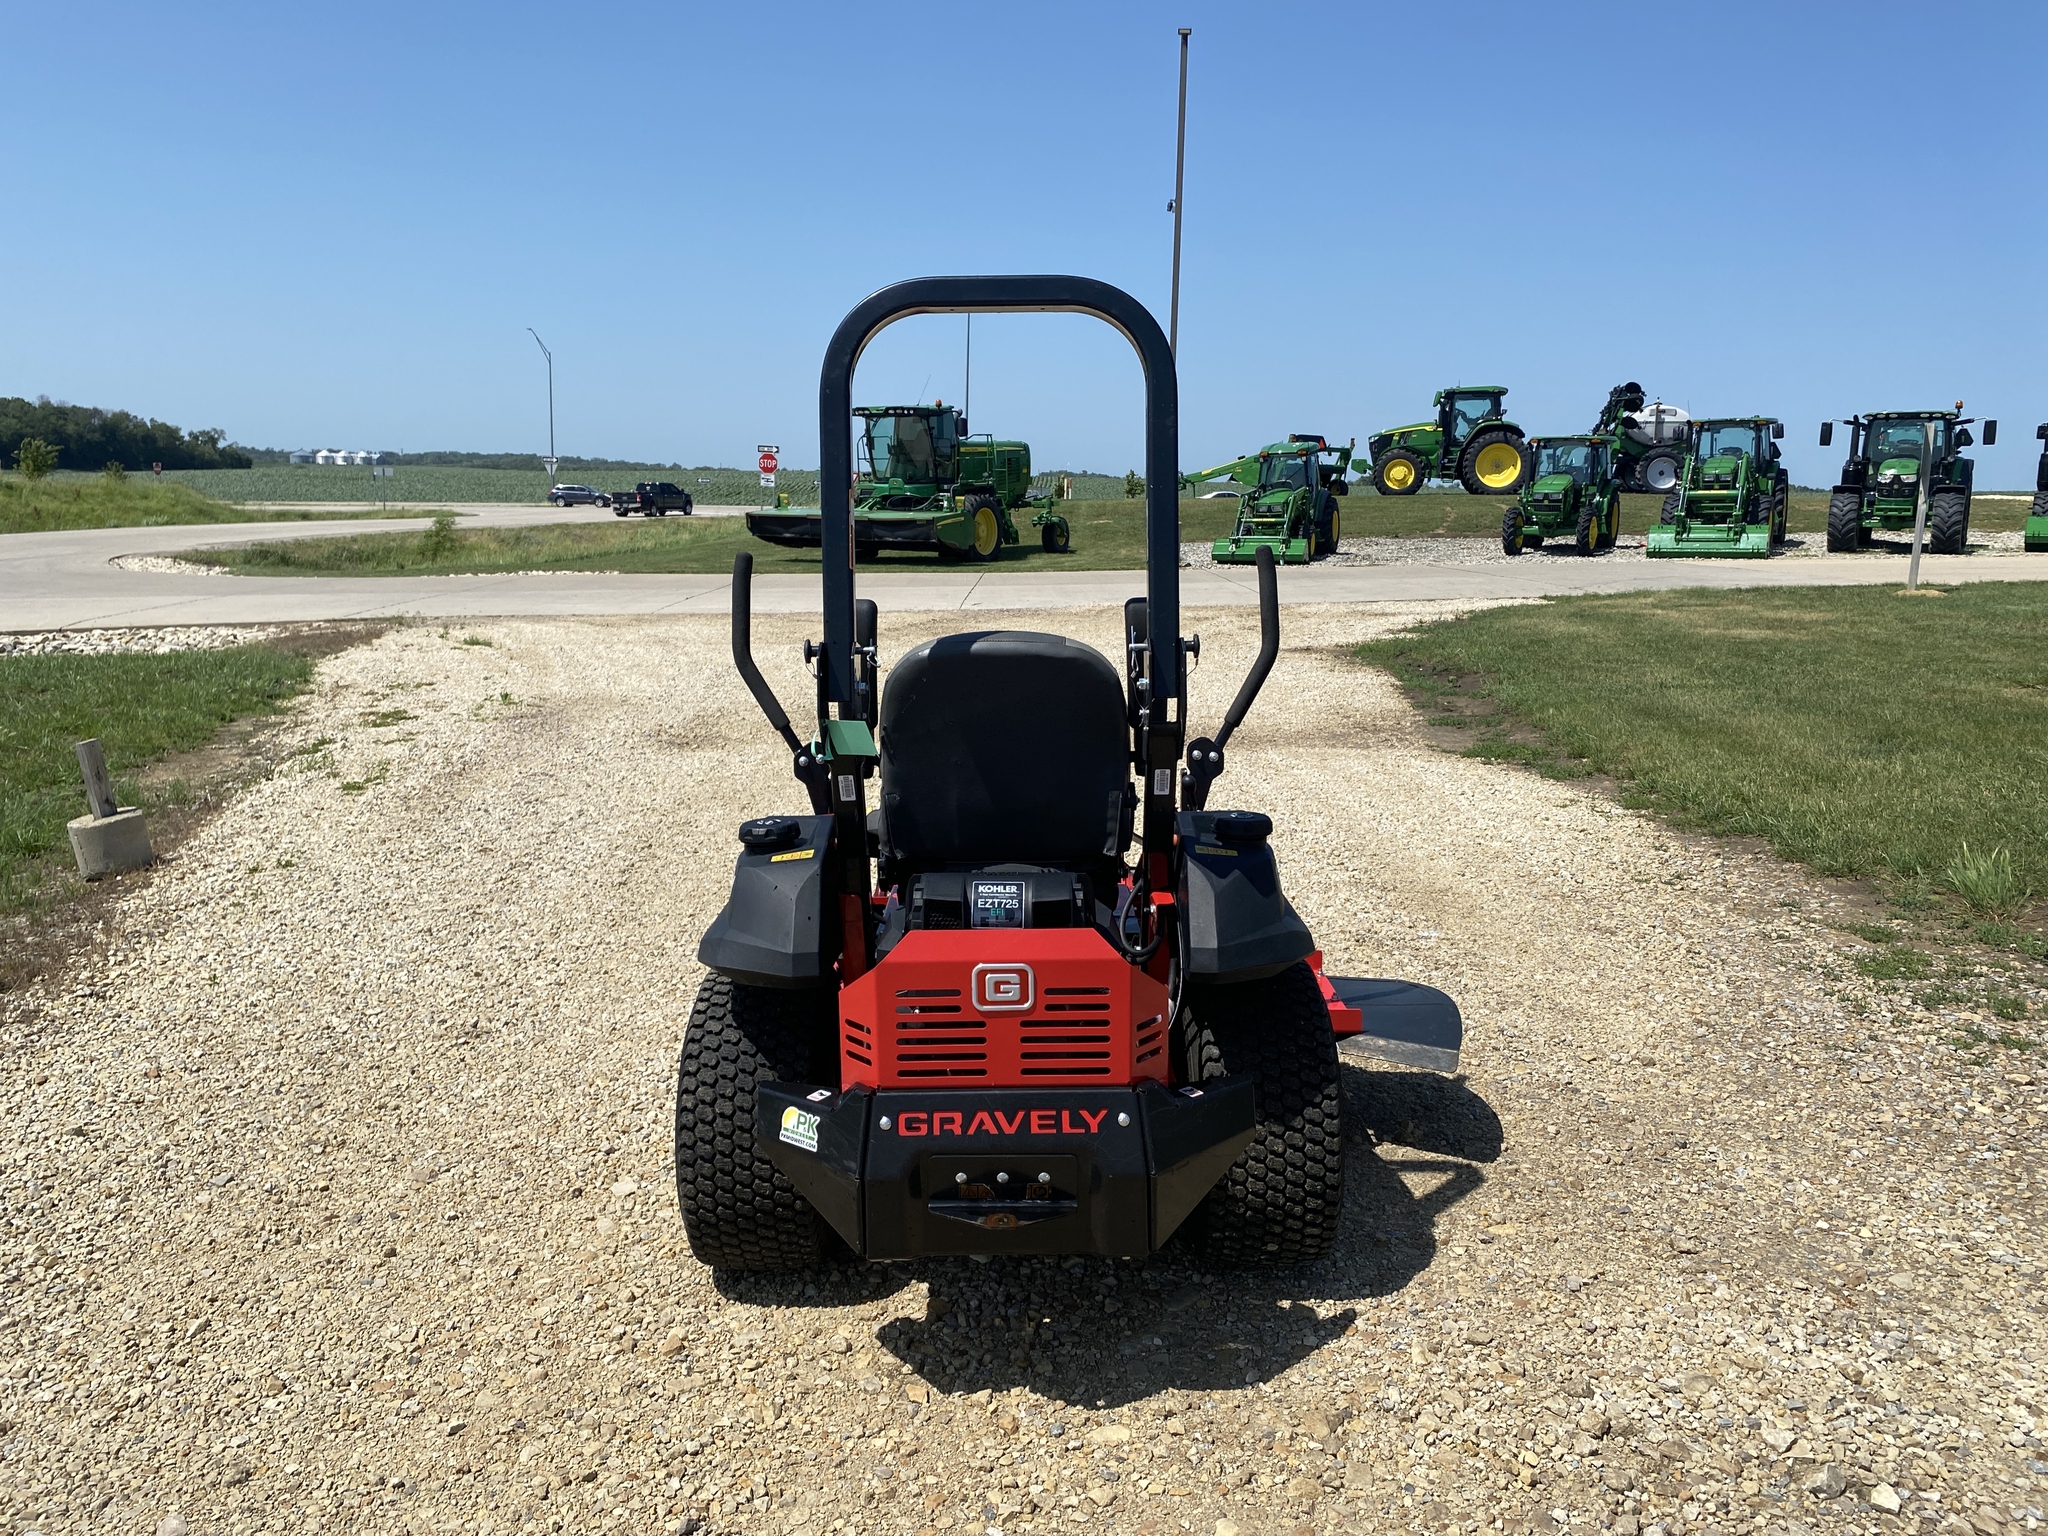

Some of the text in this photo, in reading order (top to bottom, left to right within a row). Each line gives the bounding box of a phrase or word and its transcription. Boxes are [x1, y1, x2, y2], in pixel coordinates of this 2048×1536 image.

[760, 459, 776, 468] STOP
[978, 885, 1018, 893] KOHLER
[978, 899, 1019, 908] EZT725
[991, 908, 1004, 916] EFI
[985, 973, 1021, 1001] G
[898, 1108, 1108, 1136] GRAVELY
